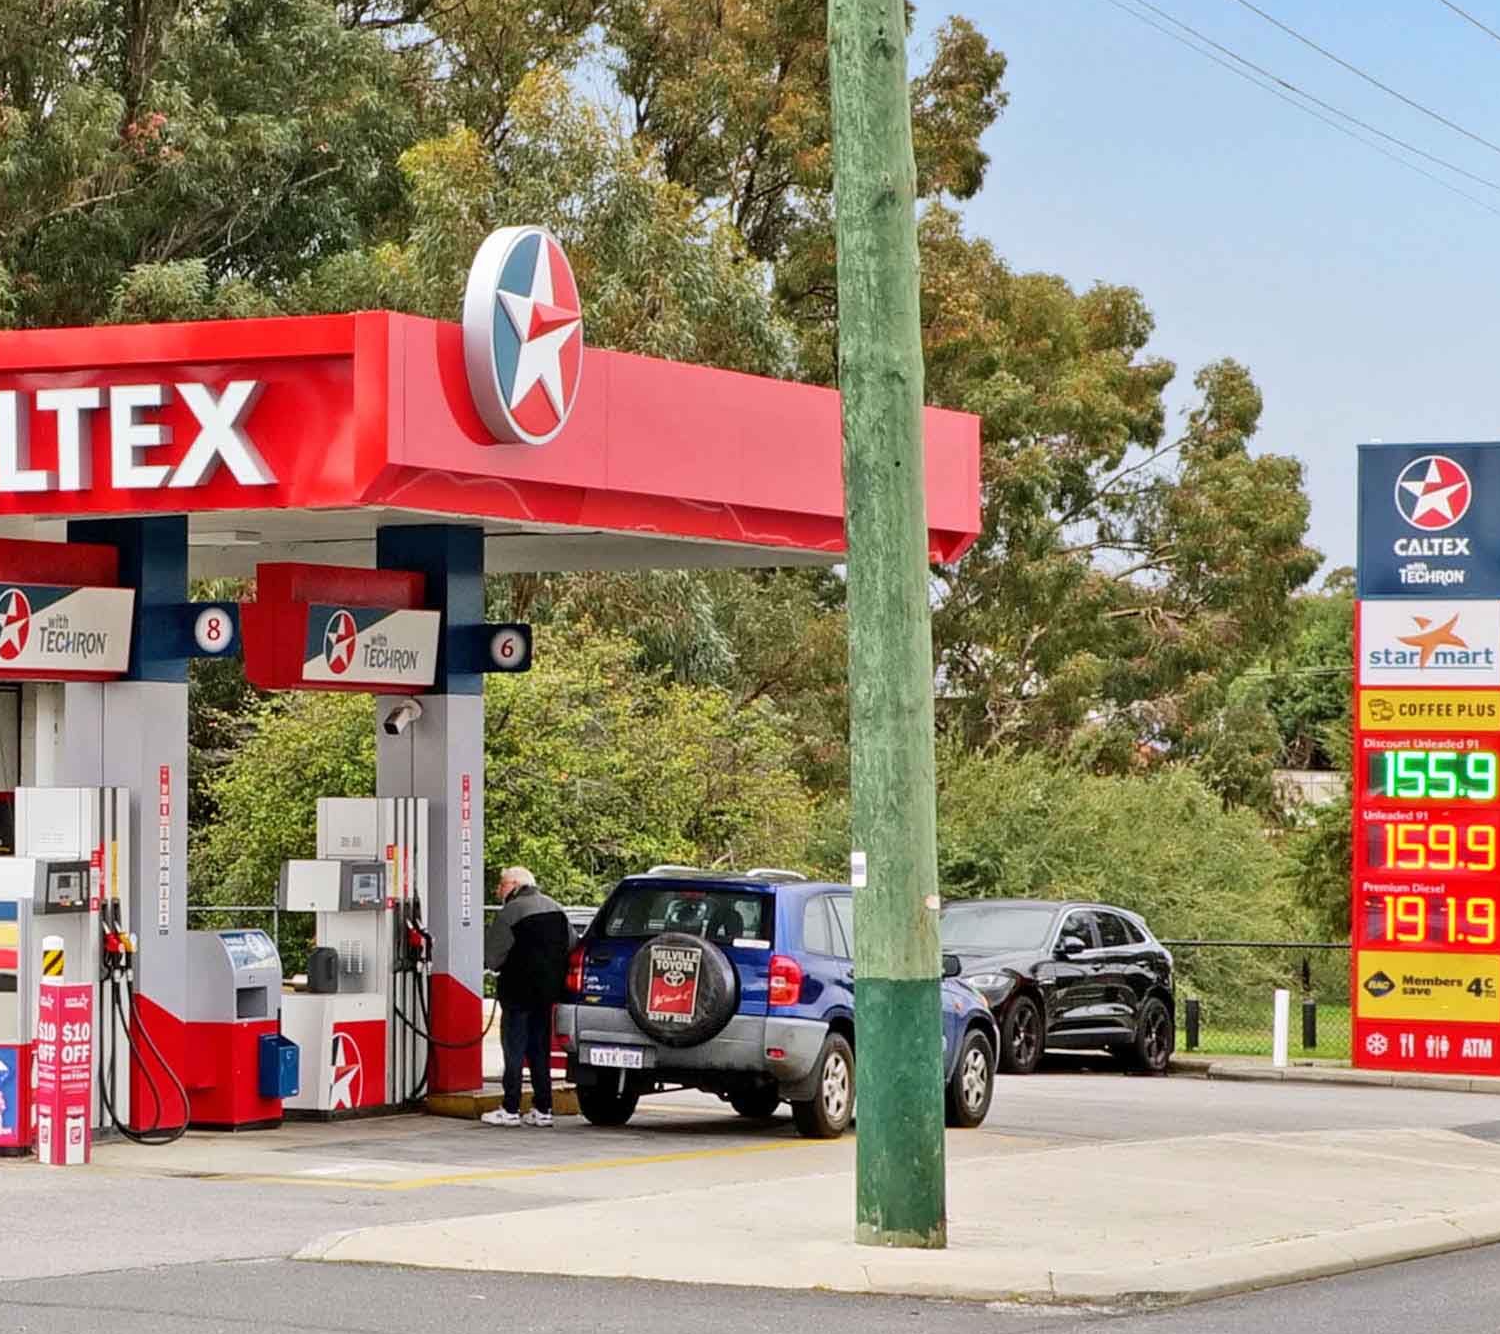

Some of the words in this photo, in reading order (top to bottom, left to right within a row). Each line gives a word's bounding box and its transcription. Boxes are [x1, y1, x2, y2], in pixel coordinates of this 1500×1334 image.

[1393, 538, 1470, 556] CALTEX
[1406, 562, 1427, 571] with
[1399, 569, 1465, 586] TECHRON
[48, 614, 69, 629] with
[206, 618, 221, 641] 8
[39, 626, 107, 659] TECHRON
[371, 632, 388, 646] with
[501, 638, 514, 658] 6
[1369, 649, 1420, 665] star
[1435, 648, 1494, 665] mart
[363, 644, 419, 674] TECHRON
[1399, 703, 1452, 717] COFFEE
[1457, 703, 1496, 717] PLUS
[1363, 739, 1411, 749] Discount
[1413, 740, 1464, 749] Unleaded
[1466, 740, 1479, 749] 91
[1384, 750, 1498, 799] 155.9
[1363, 810, 1413, 820] Unleaded
[1415, 811, 1429, 820] 91
[1384, 823, 1497, 871] 159.9
[1363, 882, 1410, 892] Premium
[1412, 883, 1445, 893] Diesel
[1384, 896, 1496, 944] 191.9
[653, 949, 699, 964] MELVILLE
[656, 960, 694, 972] TOYOTA
[1402, 975, 1463, 988] Members
[1467, 977, 1482, 997] 4
[1402, 987, 1431, 996] save
[61, 1021, 91, 1043] $10
[61, 1044, 91, 1064] OFF
[1462, 1038, 1493, 1058] ATM
